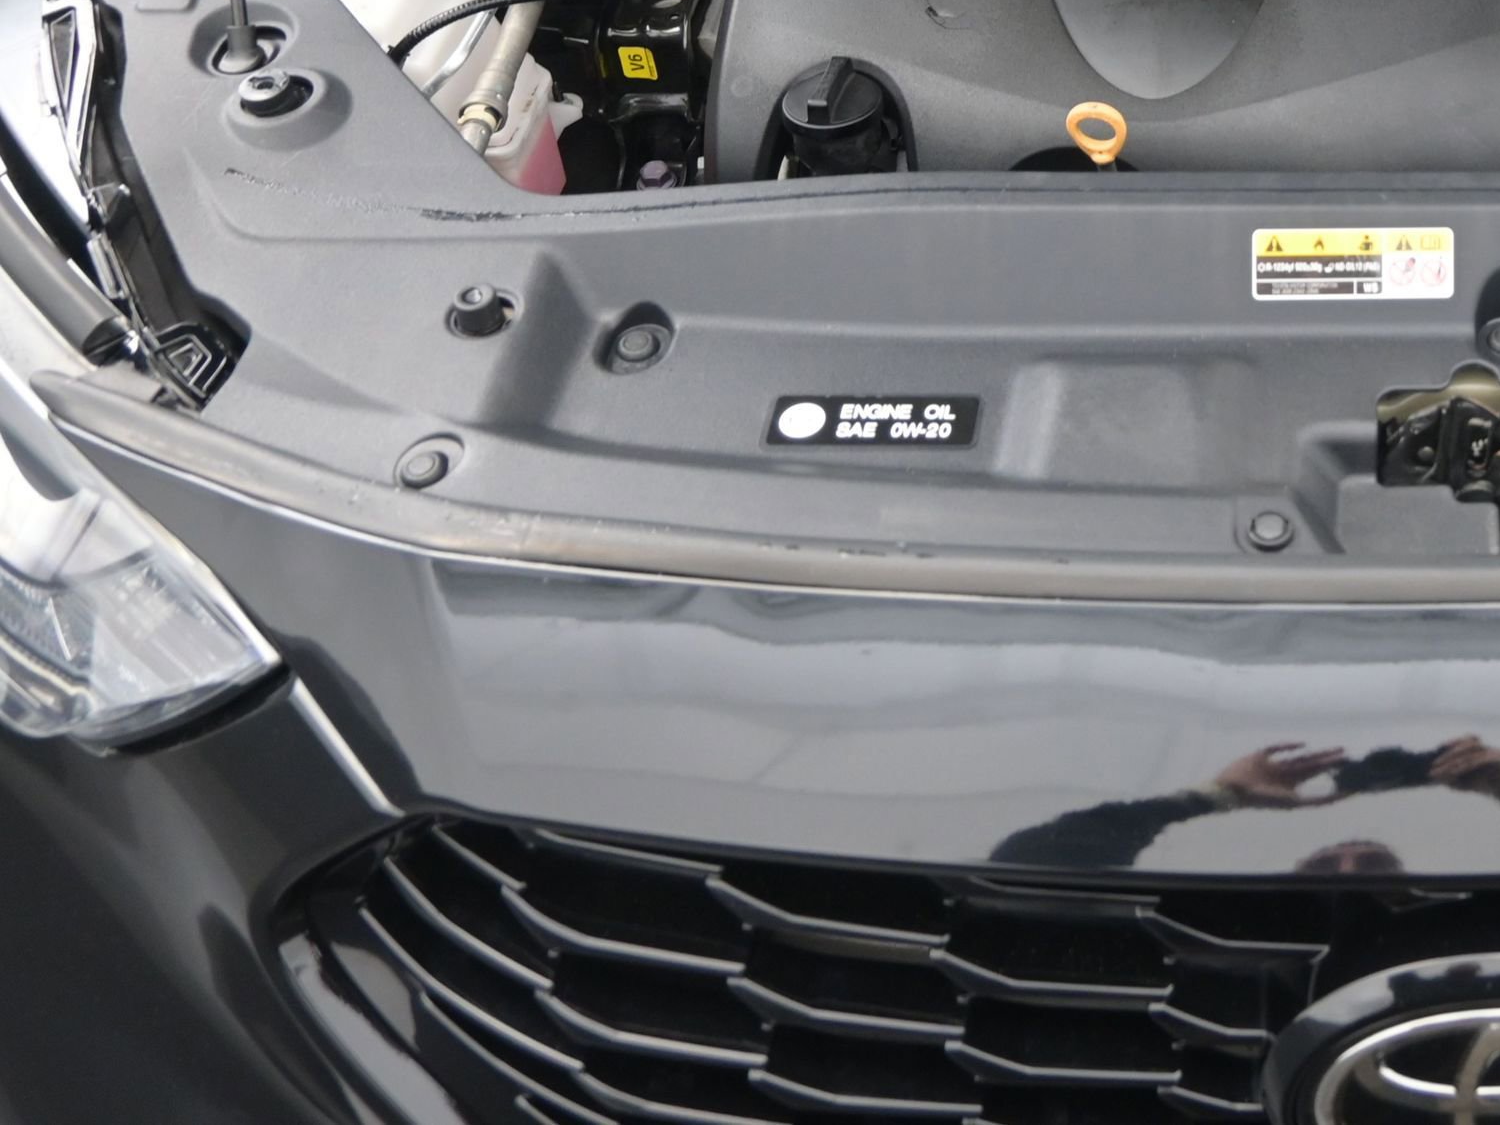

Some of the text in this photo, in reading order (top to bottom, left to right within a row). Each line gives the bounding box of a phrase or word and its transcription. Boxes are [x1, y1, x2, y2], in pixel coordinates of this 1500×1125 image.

[628, 53, 645, 72] V6
[839, 403, 956, 421] ENGINE OIL
[835, 421, 952, 438] SAE 0W-20
